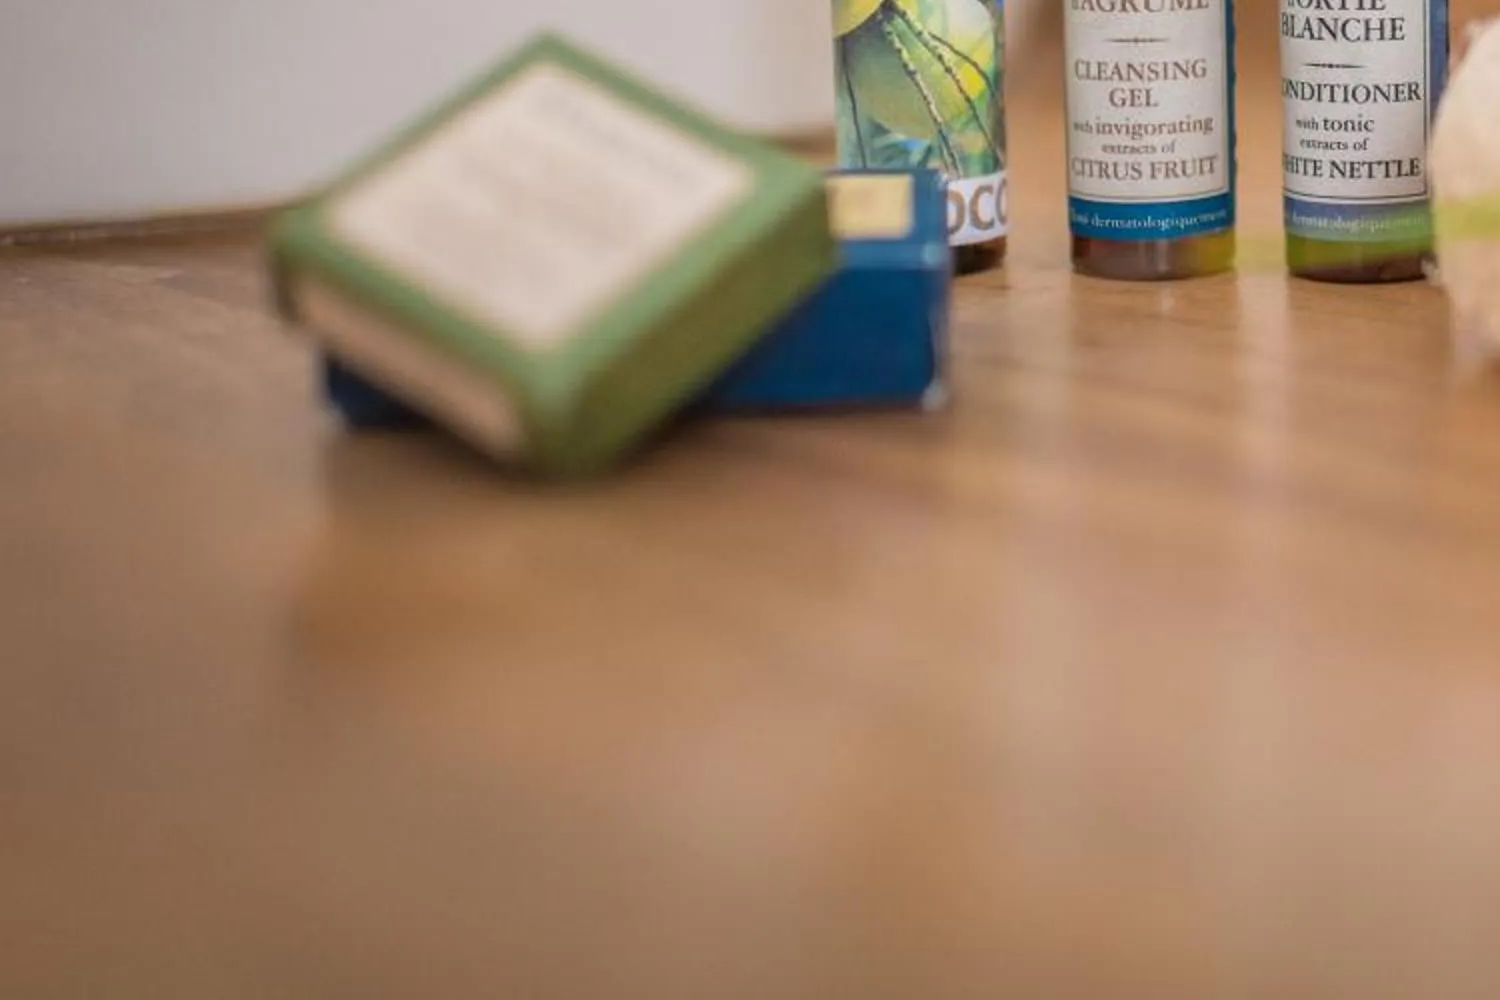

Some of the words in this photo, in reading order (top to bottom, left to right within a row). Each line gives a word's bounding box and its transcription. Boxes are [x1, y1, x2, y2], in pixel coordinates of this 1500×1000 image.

[1281, 11, 1406, 42] BLANCHE
[1074, 58, 1208, 81] CLEANSING
[1109, 87, 1159, 107] GEL
[1096, 115, 1214, 140] invigorating
[1323, 114, 1375, 132] tonic
[1101, 142, 1157, 154] extracts
[1161, 139, 1178, 154] of
[1300, 138, 1349, 151] extracts
[1353, 137, 1370, 151] of
[1071, 156, 1143, 181] CITRUS
[1150, 155, 1217, 180] FRUIT
[1283, 153, 1324, 177] HITE
[1329, 158, 1421, 179] NETTLE
